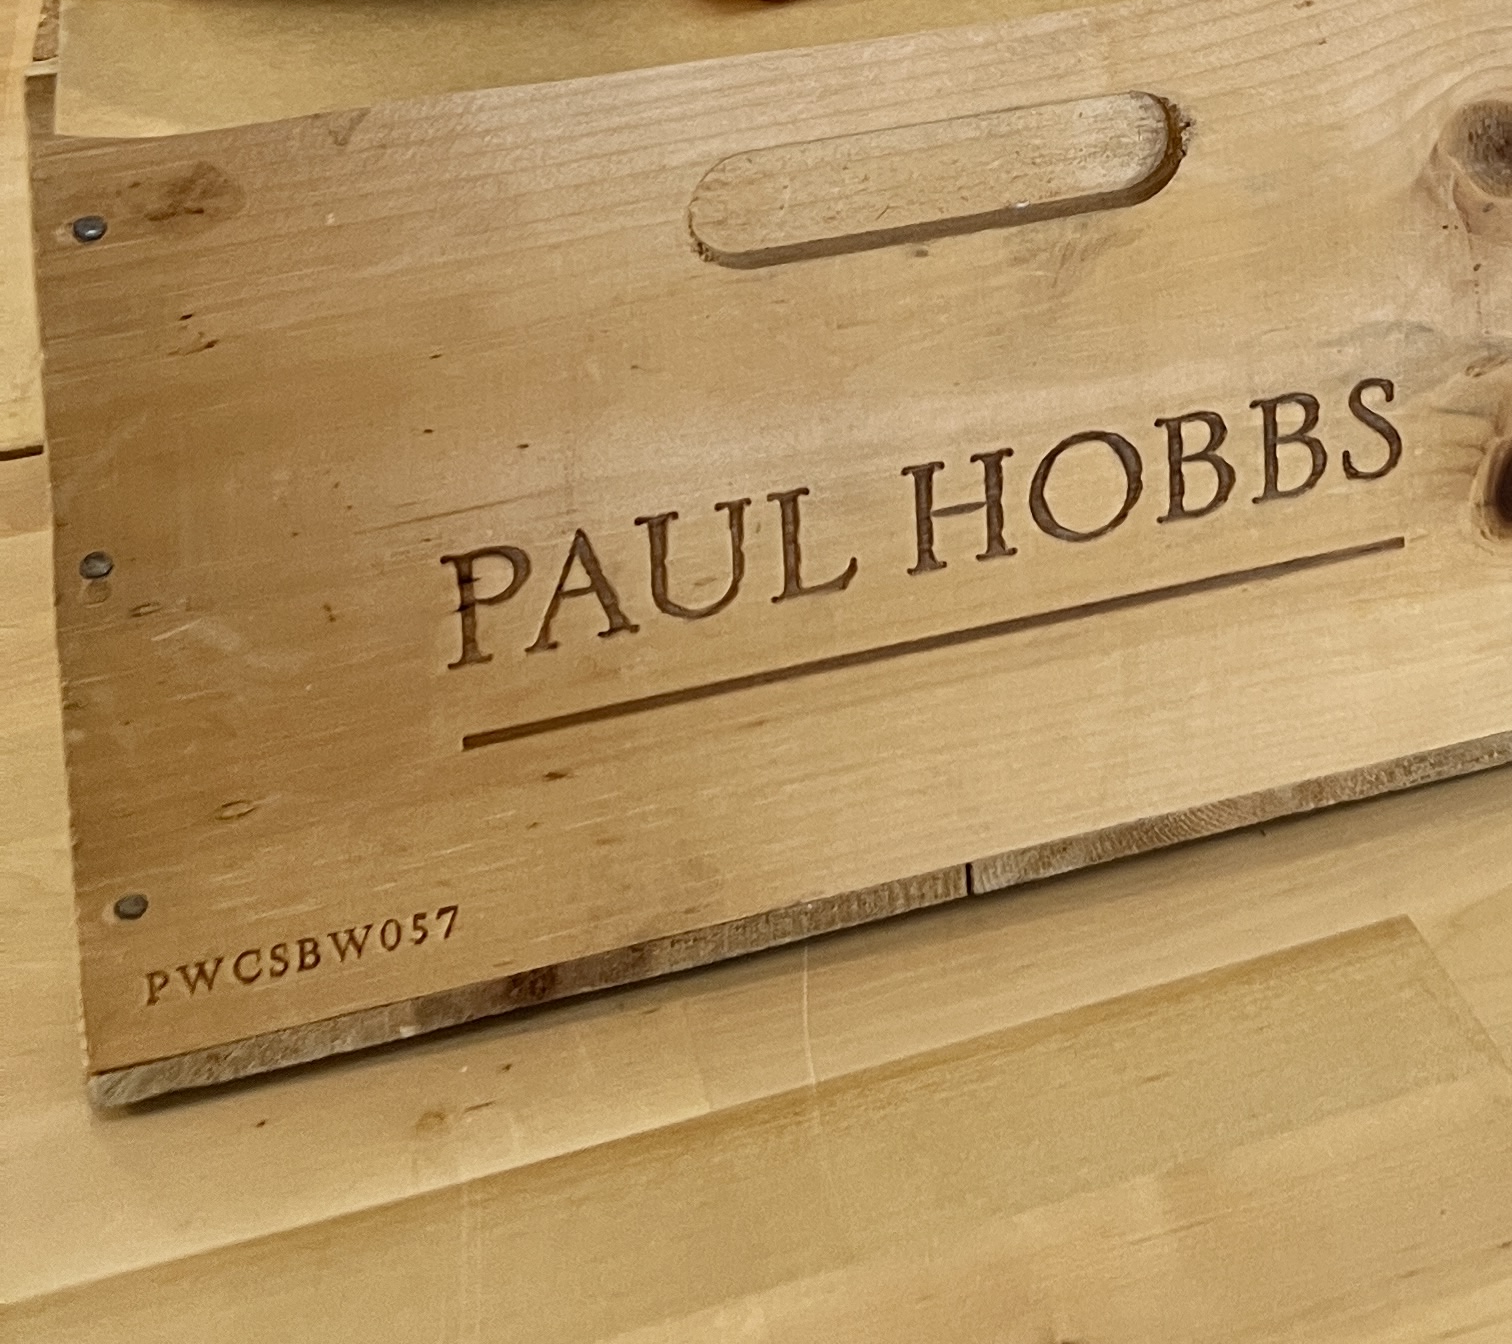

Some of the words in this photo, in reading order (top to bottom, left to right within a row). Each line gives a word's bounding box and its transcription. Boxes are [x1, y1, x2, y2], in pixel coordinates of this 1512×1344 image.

[440, 486, 858, 671] PAUL
[900, 377, 1404, 575] HOBBS
[145, 904, 460, 1006] PWCSBW057
